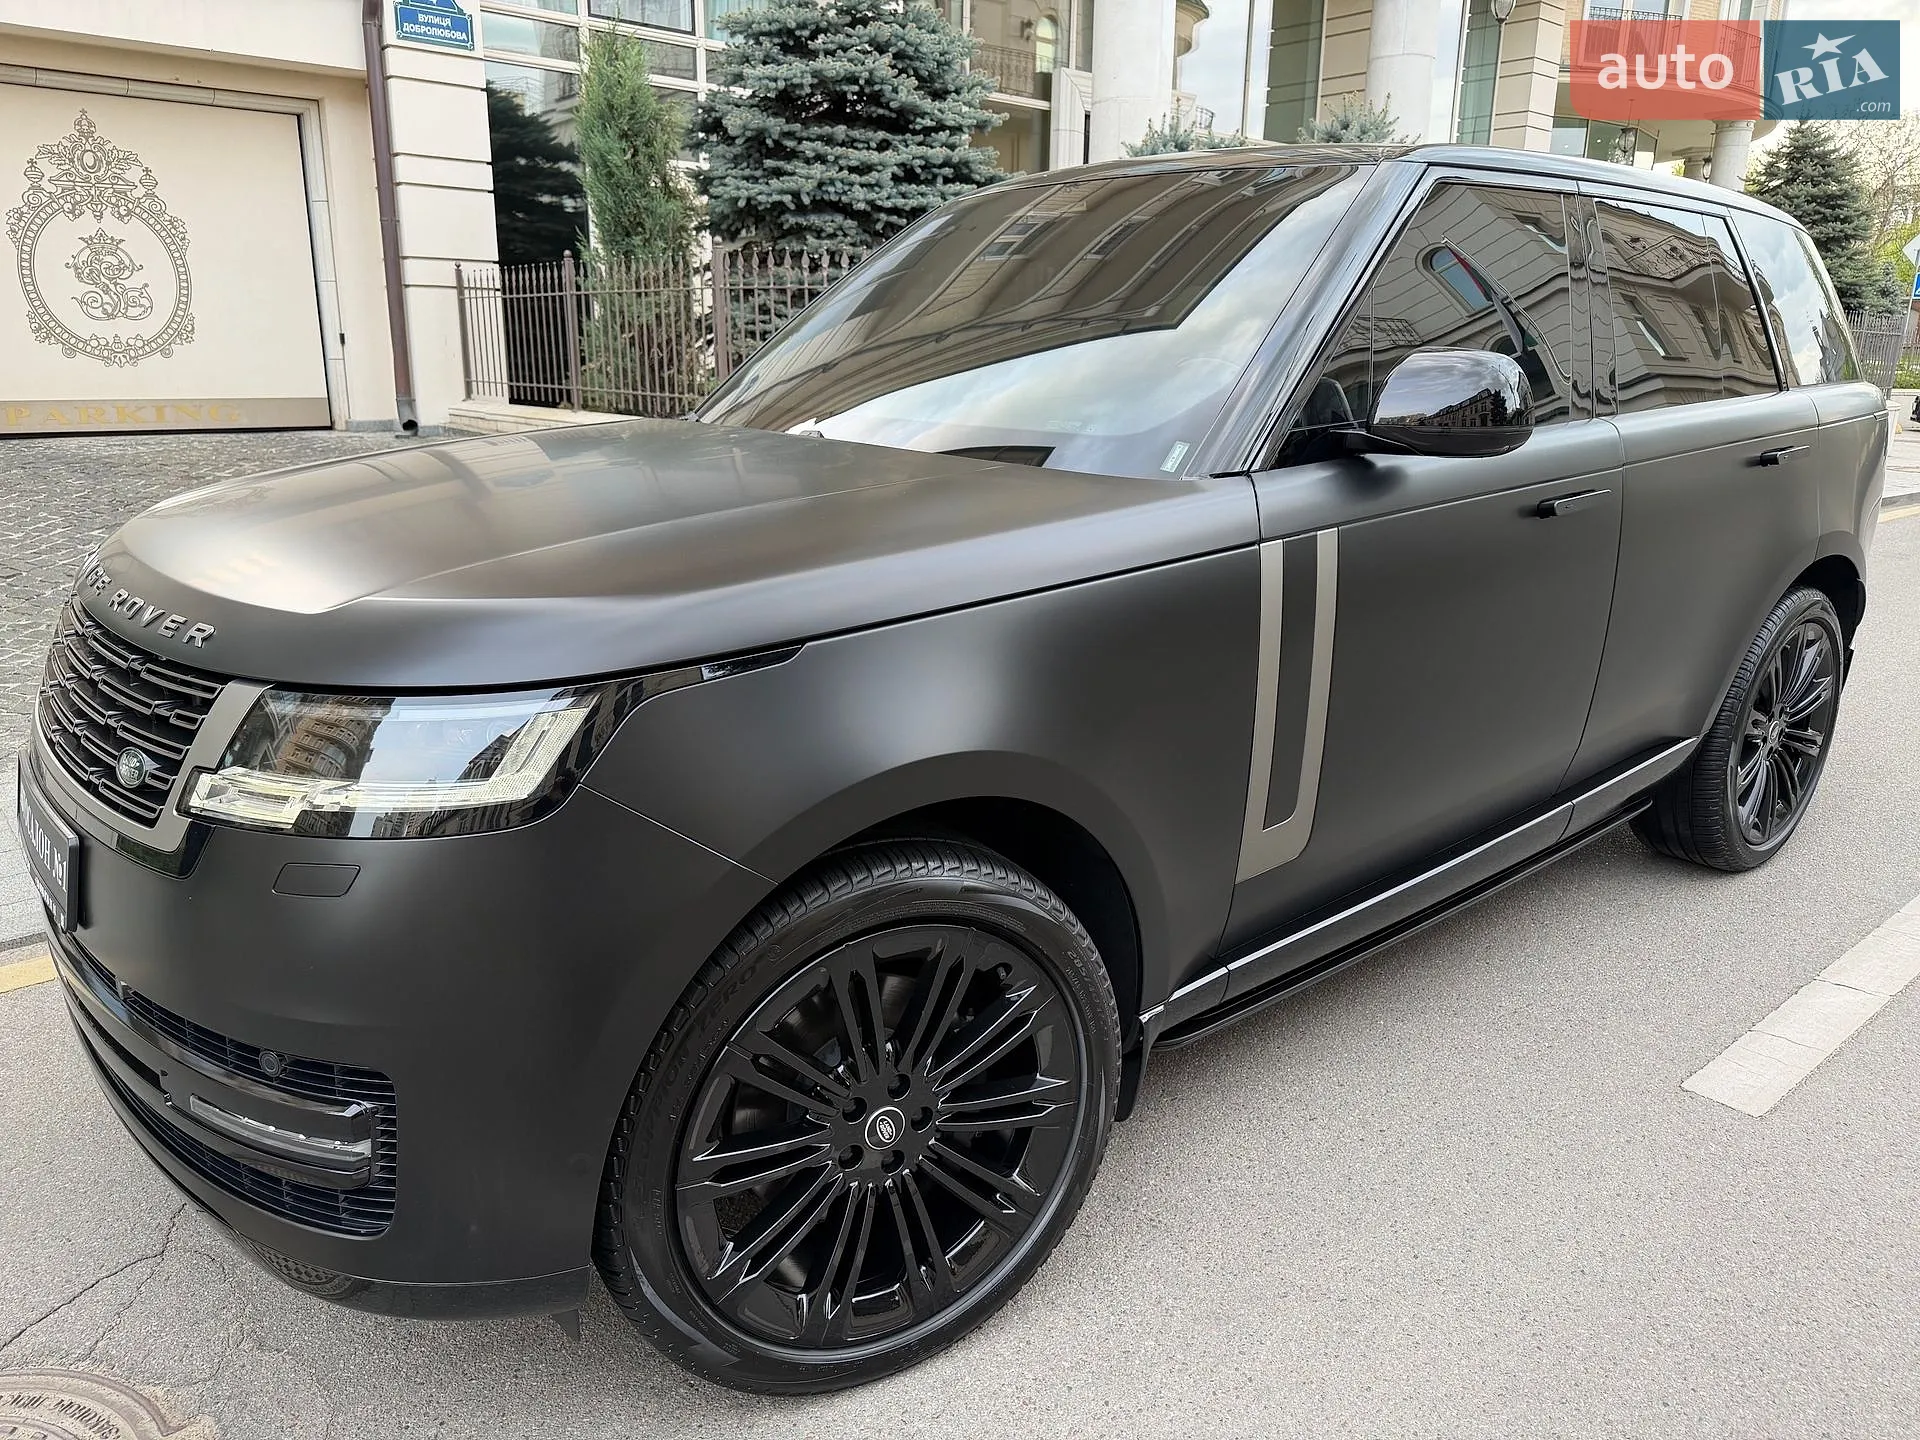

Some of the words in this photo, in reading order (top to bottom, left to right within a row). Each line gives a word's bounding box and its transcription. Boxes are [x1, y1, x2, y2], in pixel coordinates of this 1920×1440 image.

[417, 13, 452, 27] ВУЛИЦЯ
[402, 22, 468, 41] ДОБРОЛЮБОВА
[1, 404, 241, 427] PARKING
[108, 588, 217, 648] ROVER
